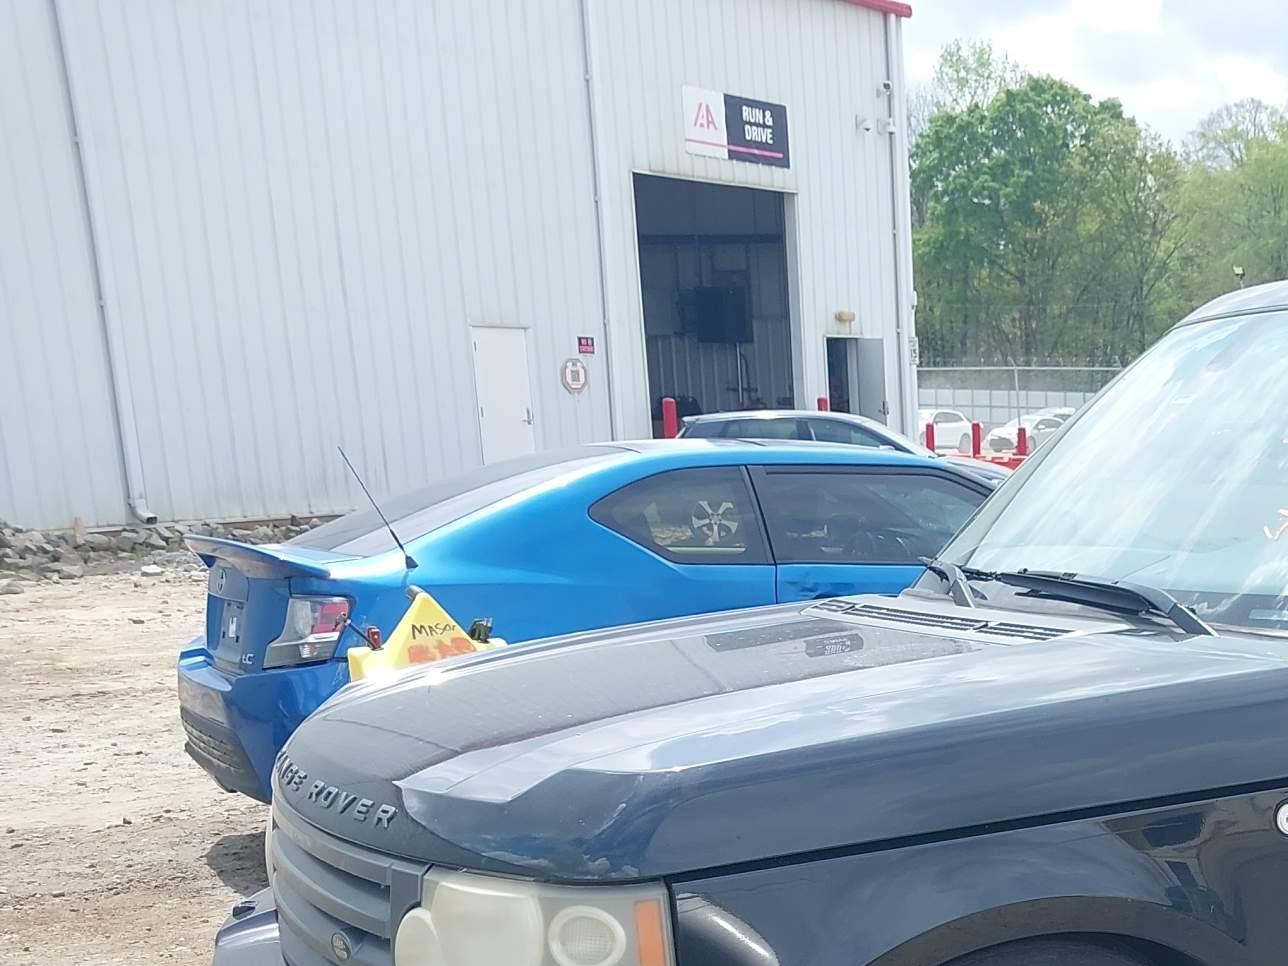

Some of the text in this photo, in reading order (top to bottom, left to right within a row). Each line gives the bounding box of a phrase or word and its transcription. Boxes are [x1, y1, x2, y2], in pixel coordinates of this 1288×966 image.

[742, 105, 773, 126] RUN &
[745, 124, 773, 144] DRIVE
[308, 779, 399, 828] ROVER
